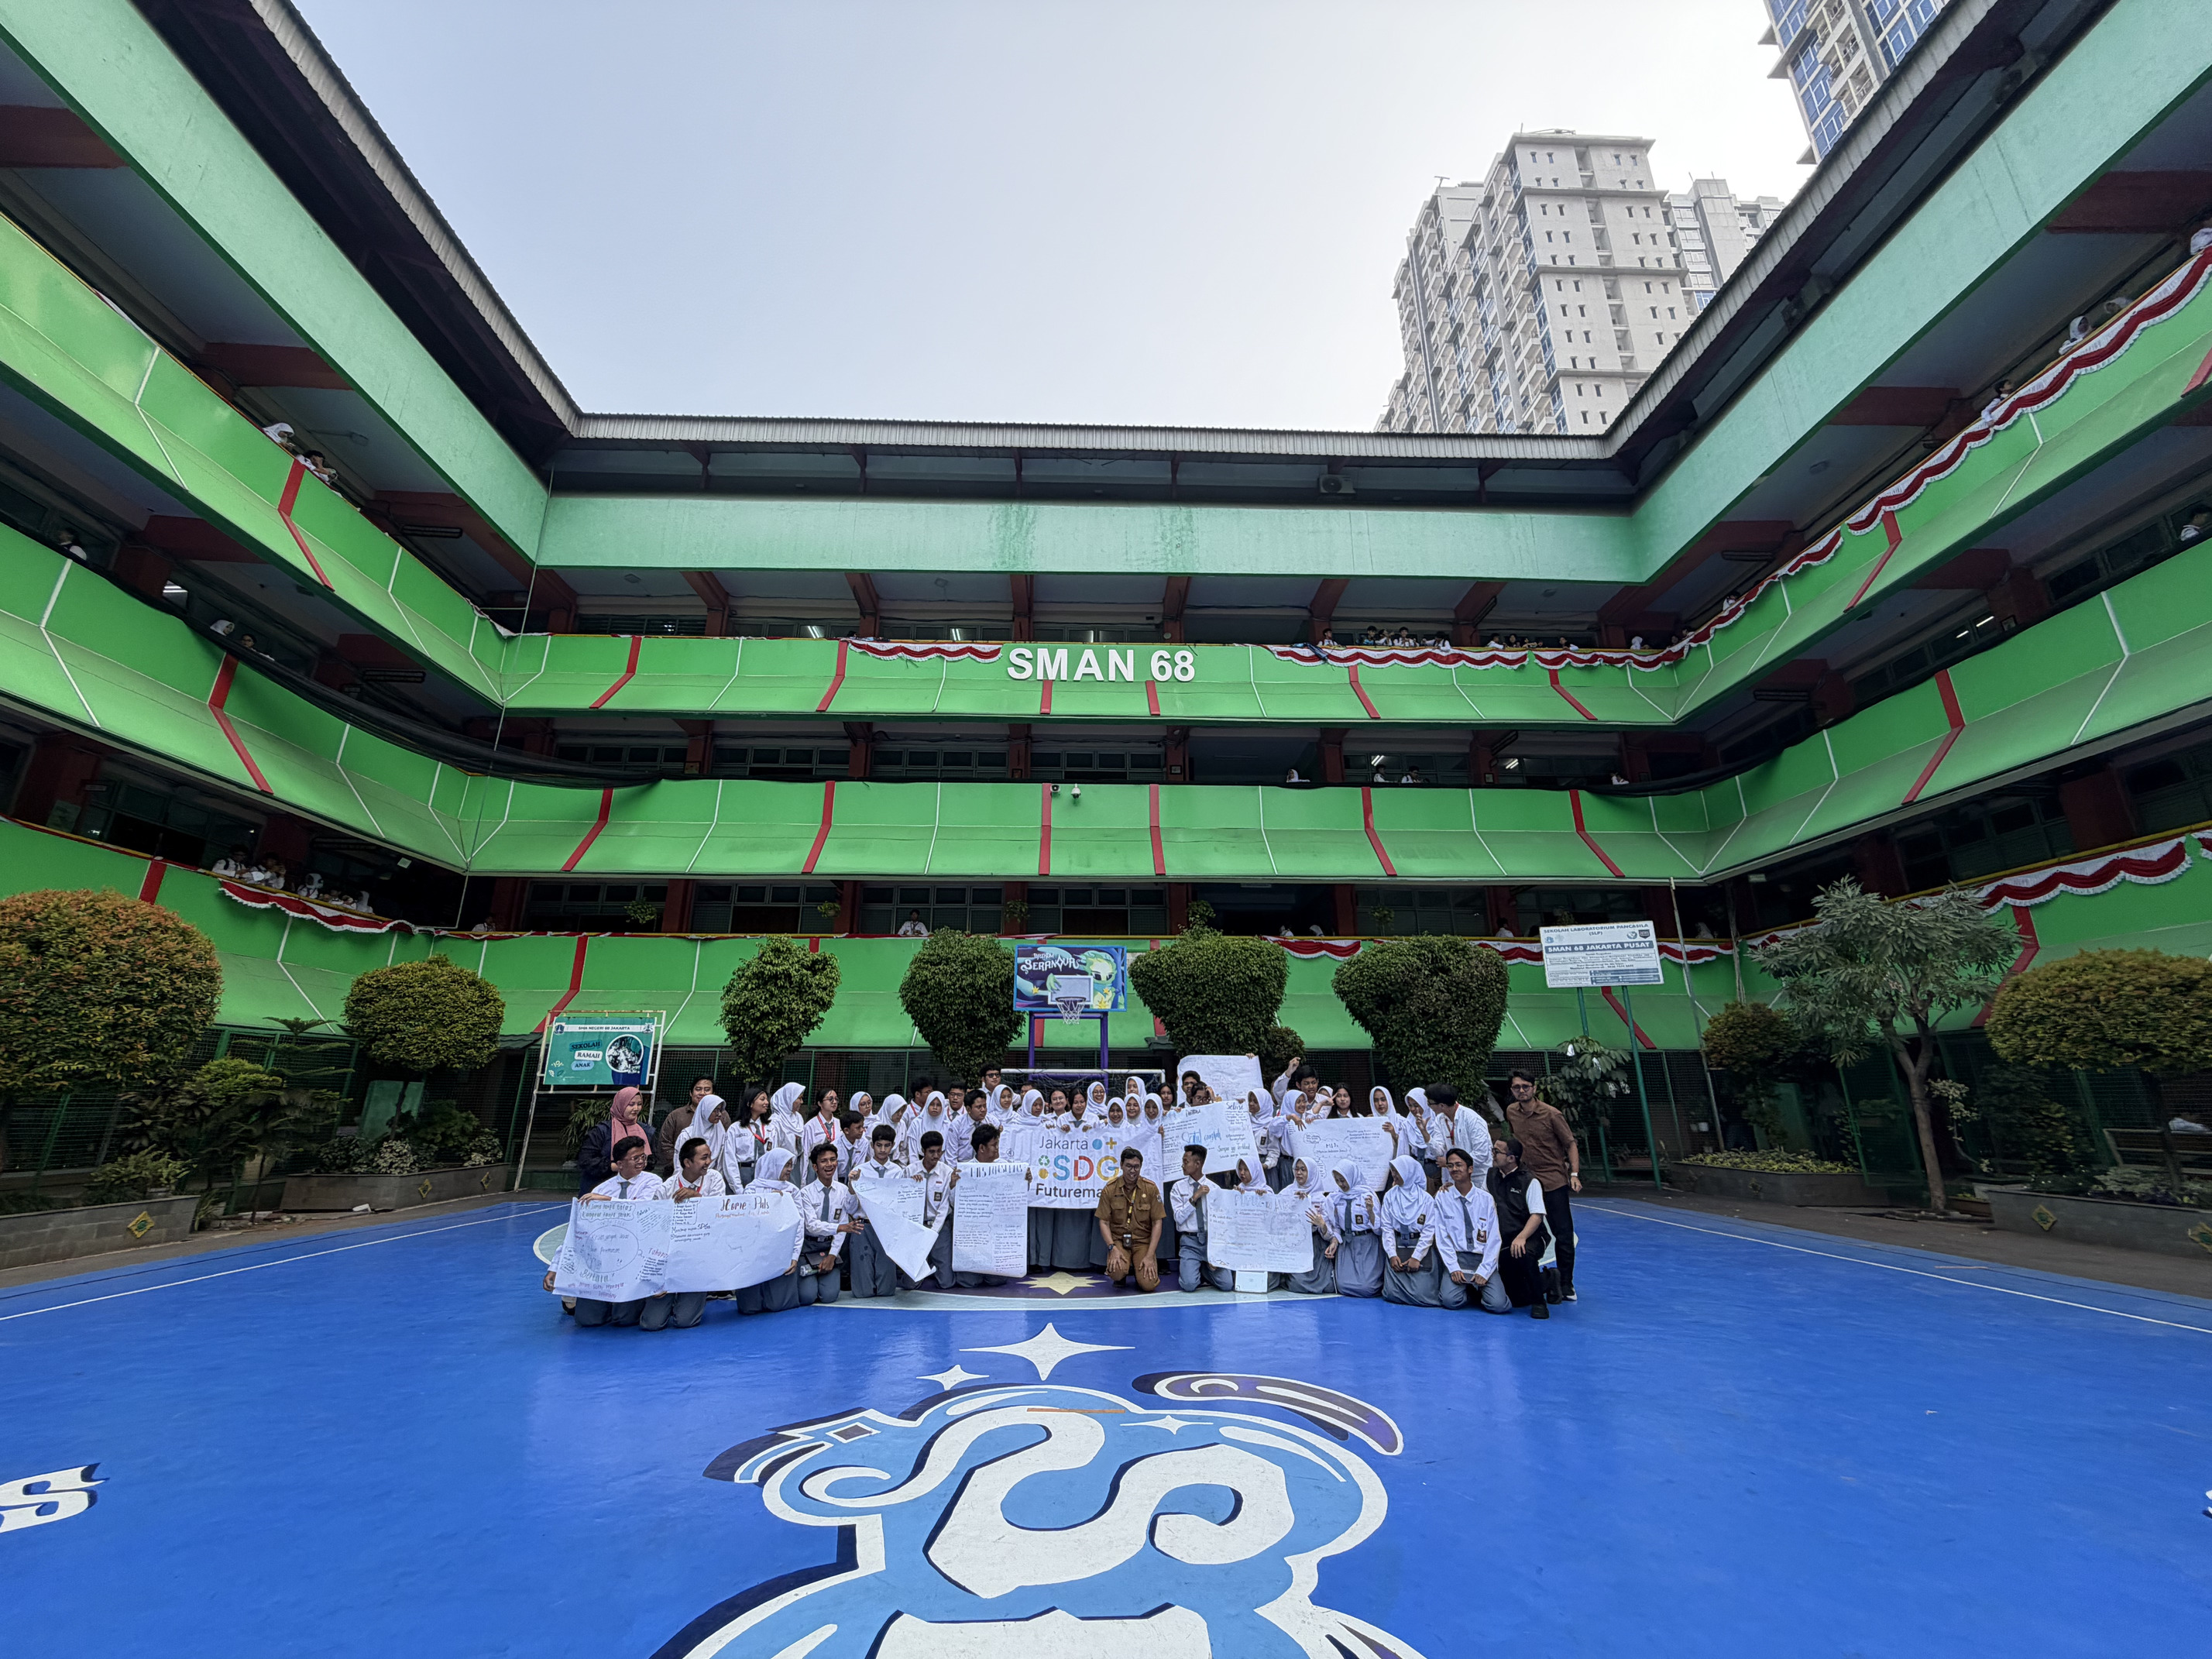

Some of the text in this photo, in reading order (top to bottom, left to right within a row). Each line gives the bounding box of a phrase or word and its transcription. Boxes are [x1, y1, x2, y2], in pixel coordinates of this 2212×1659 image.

[1007, 647, 1195, 682] SMAN 68
[572, 1041, 600, 1050] SEKOLAH
[1039, 1135, 1088, 1150] Jakarta
[1053, 1154, 1119, 1182] SDG
